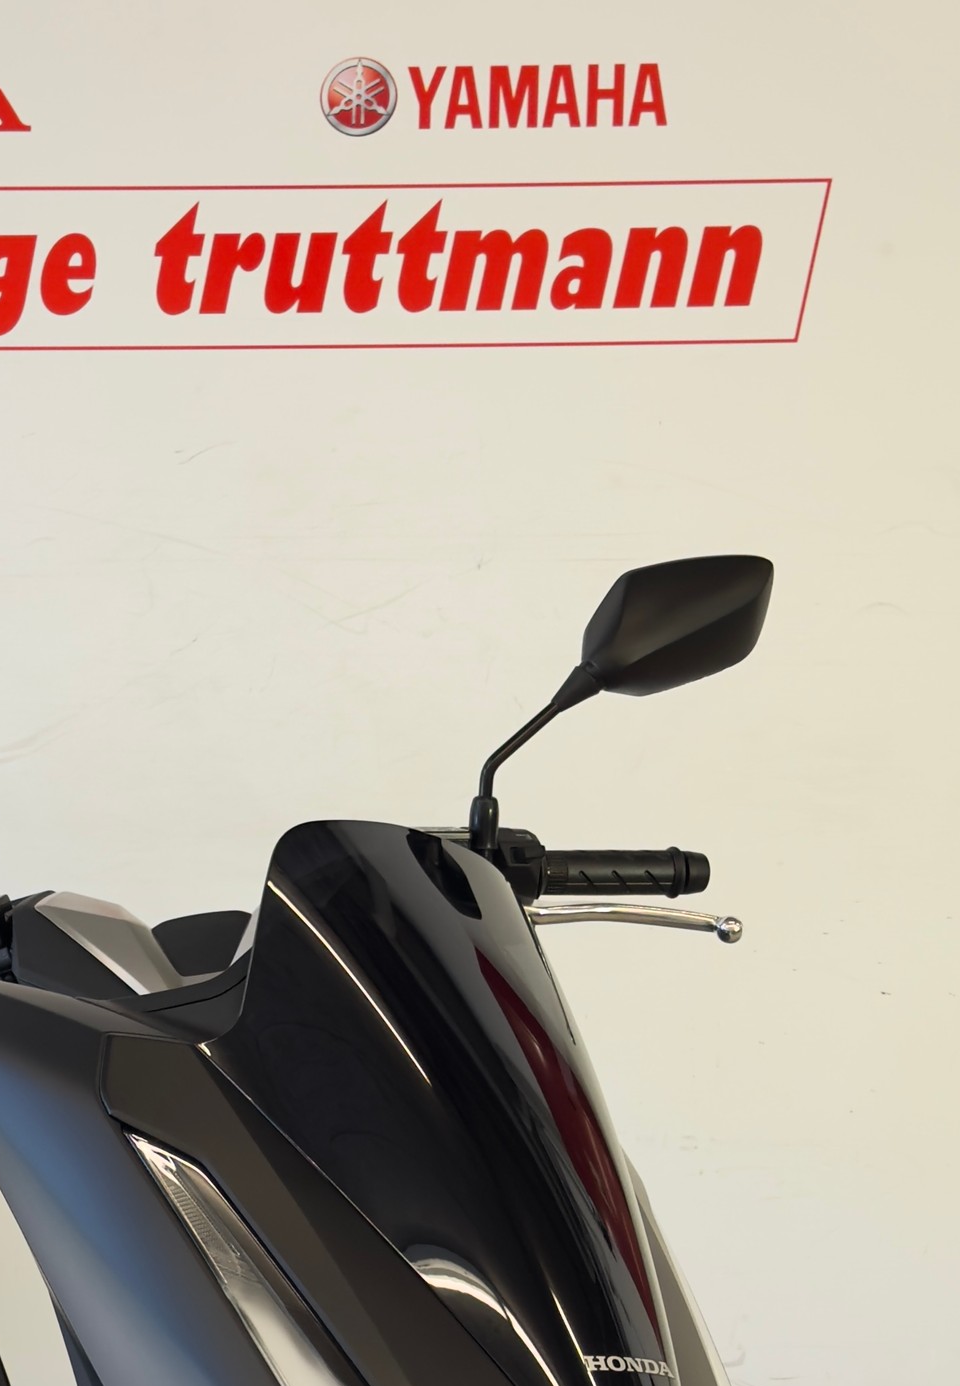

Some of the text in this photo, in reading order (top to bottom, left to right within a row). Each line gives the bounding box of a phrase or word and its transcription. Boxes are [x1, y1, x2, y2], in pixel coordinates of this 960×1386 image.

[409, 63, 668, 129] YAMAHA
[155, 199, 762, 315] truttmann
[584, 1355, 675, 1378] HONDA
